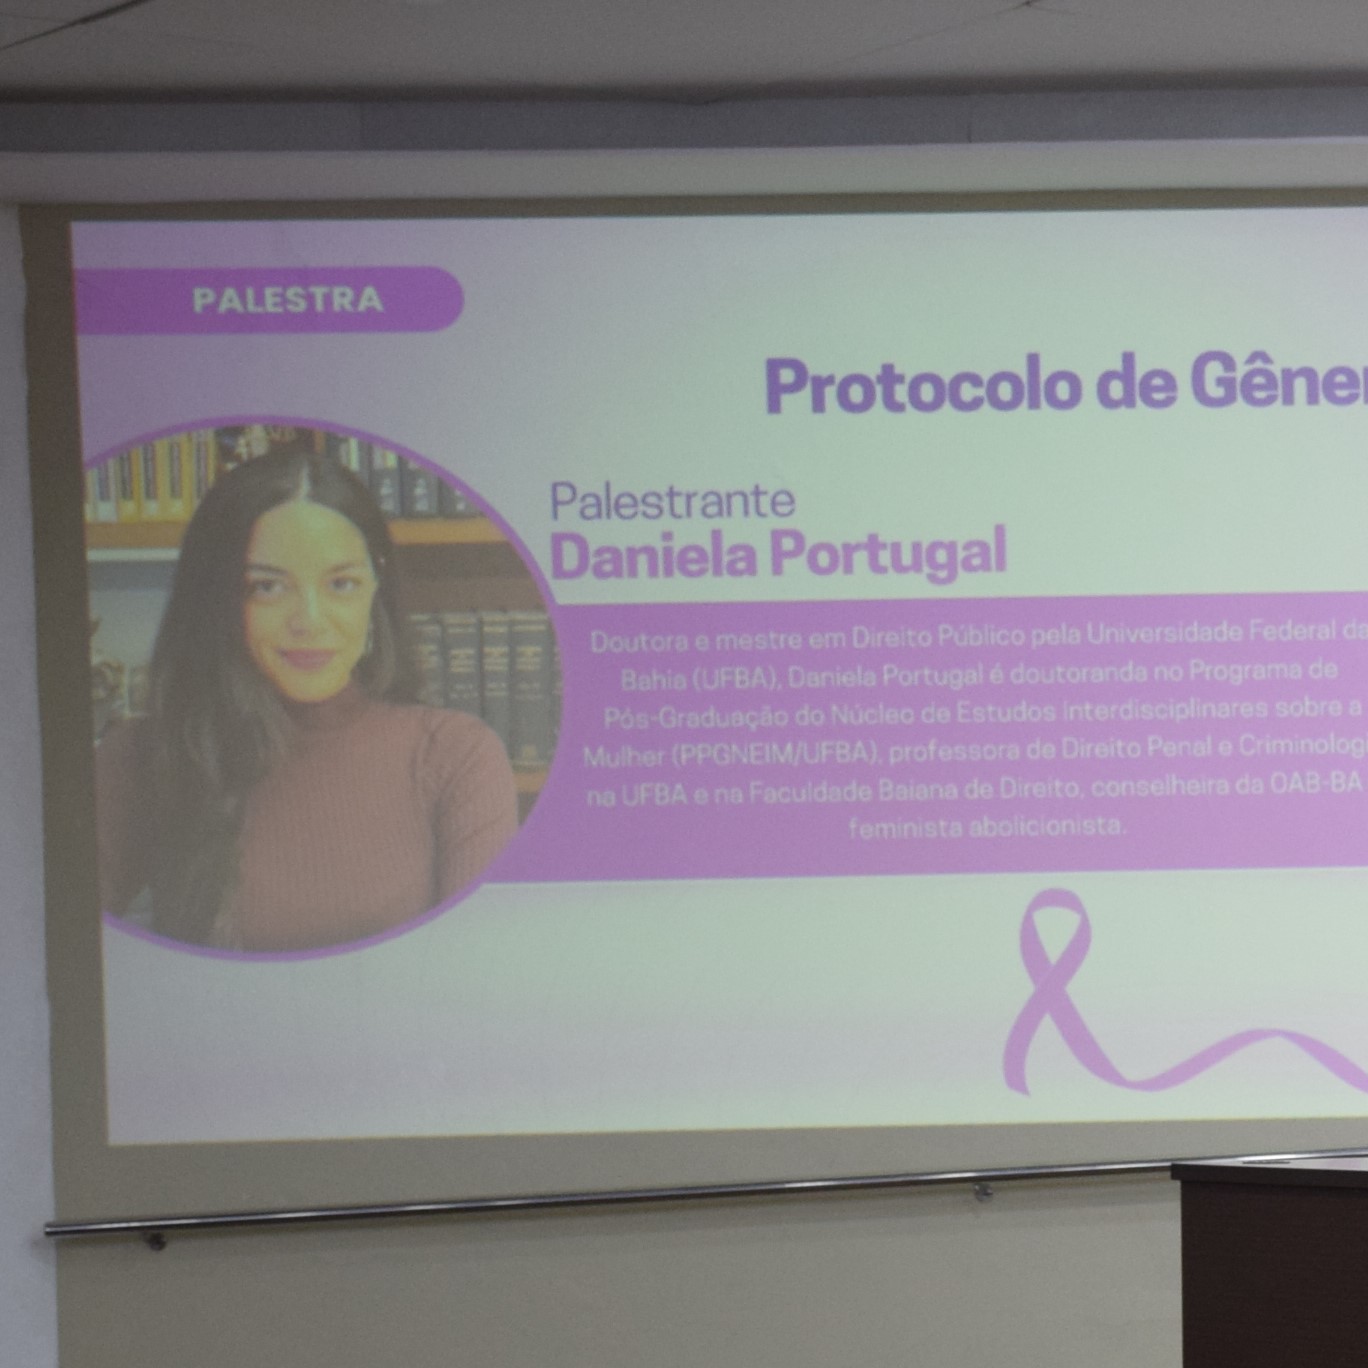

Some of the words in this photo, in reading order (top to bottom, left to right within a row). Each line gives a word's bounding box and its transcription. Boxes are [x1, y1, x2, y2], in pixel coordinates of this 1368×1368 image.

[192, 284, 385, 315] PALESTRA
[765, 353, 1082, 414] Protocolo
[1096, 351, 1177, 409] de
[550, 481, 796, 521] Palestrante
[550, 529, 757, 580] Daniela
[770, 523, 1007, 586] Portugal
[591, 630, 688, 653] Doutora
[695, 636, 709, 651] e
[716, 632, 801, 652] mestre
[809, 632, 846, 650] em
[852, 626, 932, 648] Direito
[938, 623, 1025, 646] Público
[1031, 623, 1081, 649] pela
[1088, 620, 1243, 644] Universidade
[1249, 618, 1336, 642] Federal
[621, 669, 687, 691] Bahia
[692, 666, 782, 692] (UFBA),
[789, 666, 876, 689] Daniela
[883, 662, 983, 691] Portugal
[989, 665, 1004, 685] é
[1010, 660, 1148, 685] doutoranda
[1154, 664, 1184, 681] no
[1190, 658, 1302, 685] Programa
[1308, 657, 1339, 679] de
[604, 706, 788, 732] Pós-Graduação
[795, 704, 825, 726] do
[831, 702, 914, 725] Núcleo
[921, 701, 950, 723] de
[957, 698, 1056, 722] Estudos
[1275, 696, 1342, 718] sobre
[1349, 700, 1362, 717] a
[583, 746, 665, 769] Mulher
[889, 739, 1020, 766] professora
[1026, 739, 1056, 761] de
[1062, 735, 1141, 759] Direito
[1147, 734, 1212, 758] Penal
[1219, 739, 1233, 756] e
[587, 789, 615, 807] na
[621, 784, 687, 806] UFBA
[694, 788, 709, 804] e
[715, 787, 743, 804] na
[749, 779, 872, 804] Faculdade
[879, 778, 958, 800] Baiana
[964, 777, 993, 800] de
[1000, 775, 1084, 800] Direito,
[1091, 773, 1230, 798] conselheira
[1235, 773, 1264, 795] da
[1270, 771, 1363, 794] OAB-BA
[849, 815, 962, 840] feminista
[969, 813, 1128, 838] abolicionista.
